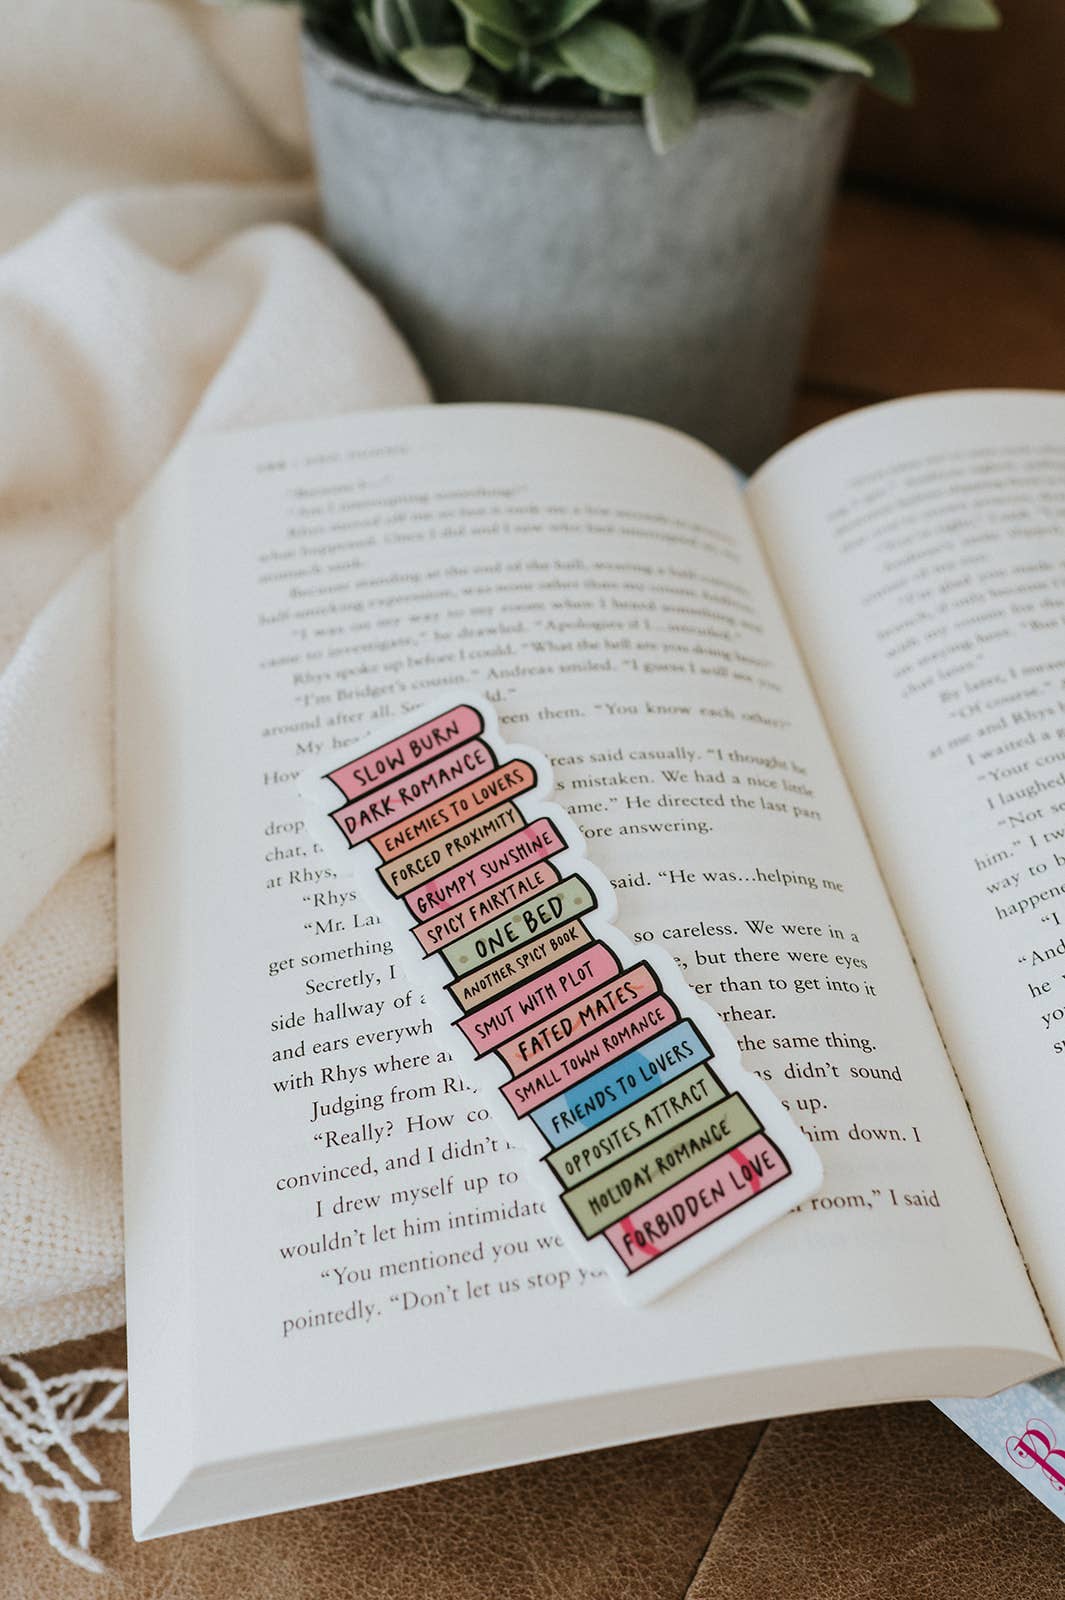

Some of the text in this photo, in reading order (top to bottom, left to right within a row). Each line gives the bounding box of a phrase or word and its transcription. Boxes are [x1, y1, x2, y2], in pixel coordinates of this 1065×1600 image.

[293, 672, 331, 686] Rhys
[407, 653, 456, 668] before
[262, 715, 321, 738] around
[326, 712, 364, 726] after
[538, 705, 585, 720] them.
[646, 702, 691, 715] know
[699, 707, 735, 719] each
[354, 721, 460, 786] SLOW BURN
[590, 748, 623, 763] said
[629, 747, 701, 762] casually.
[728, 750, 788, 770] thought
[345, 750, 486, 834] DARK ROMANCE
[572, 772, 654, 789] mistaken.
[661, 771, 687, 782] We
[694, 770, 725, 783] had
[747, 777, 777, 789] nice
[782, 779, 813, 798] little
[385, 769, 524, 852] ENEMIES TO LOVERS
[626, 794, 821, 820] He directed the last part
[619, 819, 712, 835] answering.
[390, 809, 516, 886] FORCED PROXIMITY
[267, 868, 336, 888] at Rhys,
[418, 831, 553, 913] GRUMPY SUNSHINE
[610, 872, 650, 889] said.
[658, 870, 695, 883] “He
[822, 880, 843, 892] me
[987, 864, 1047, 893] way to
[303, 891, 356, 907] “Rhys
[427, 871, 545, 944] SPICY FAIRYTALE
[304, 919, 344, 935] “Mr.
[476, 897, 562, 959] ONE BED
[634, 932, 654, 942] so
[663, 922, 737, 939] careless.
[745, 921, 773, 934] We
[782, 925, 822, 936] were
[829, 925, 844, 939] in
[269, 941, 393, 976] get something
[463, 927, 579, 1000] ANOTHER SPICY BOOK
[695, 948, 867, 969] but there were eyes
[306, 970, 380, 995] Secretly,
[720, 977, 876, 996] than to get into it
[1028, 982, 1051, 998] he
[272, 990, 412, 1031] side hallway of
[474, 961, 594, 1039] SMUT WITH PLOT
[519, 982, 638, 1061] FATED MATES
[273, 1038, 348, 1062] and ears
[515, 1008, 665, 1103] SMALL TOWN ROMANCE
[737, 1032, 876, 1053] the same thing.
[274, 1055, 429, 1092] with Rhys where
[552, 1041, 694, 1134] FRIENDS TO LOVERS
[785, 1062, 902, 1081] didn’t sound
[310, 1086, 435, 1122] Judging from
[797, 1099, 827, 1114] up.
[314, 1115, 454, 1148] “Really? How
[565, 1079, 709, 1176] OPPOSITES ATTRACT
[849, 1123, 906, 1141] down.
[912, 1127, 920, 1142] I
[277, 1137, 497, 1190] convinced, and I didn’t
[588, 1120, 731, 1216] HOLIDAY ROMANCE
[317, 1172, 518, 1217] I drew myself up to
[622, 1151, 775, 1256] FORBIDDEN LOVE
[810, 1189, 940, 1210] room,” I said
[280, 1229, 365, 1259] wouldn’t
[373, 1225, 395, 1242] let
[404, 1218, 440, 1237] him
[321, 1241, 528, 1285] “You mentioned you
[283, 1271, 570, 1338] pointedly. “Don’t let us stop
